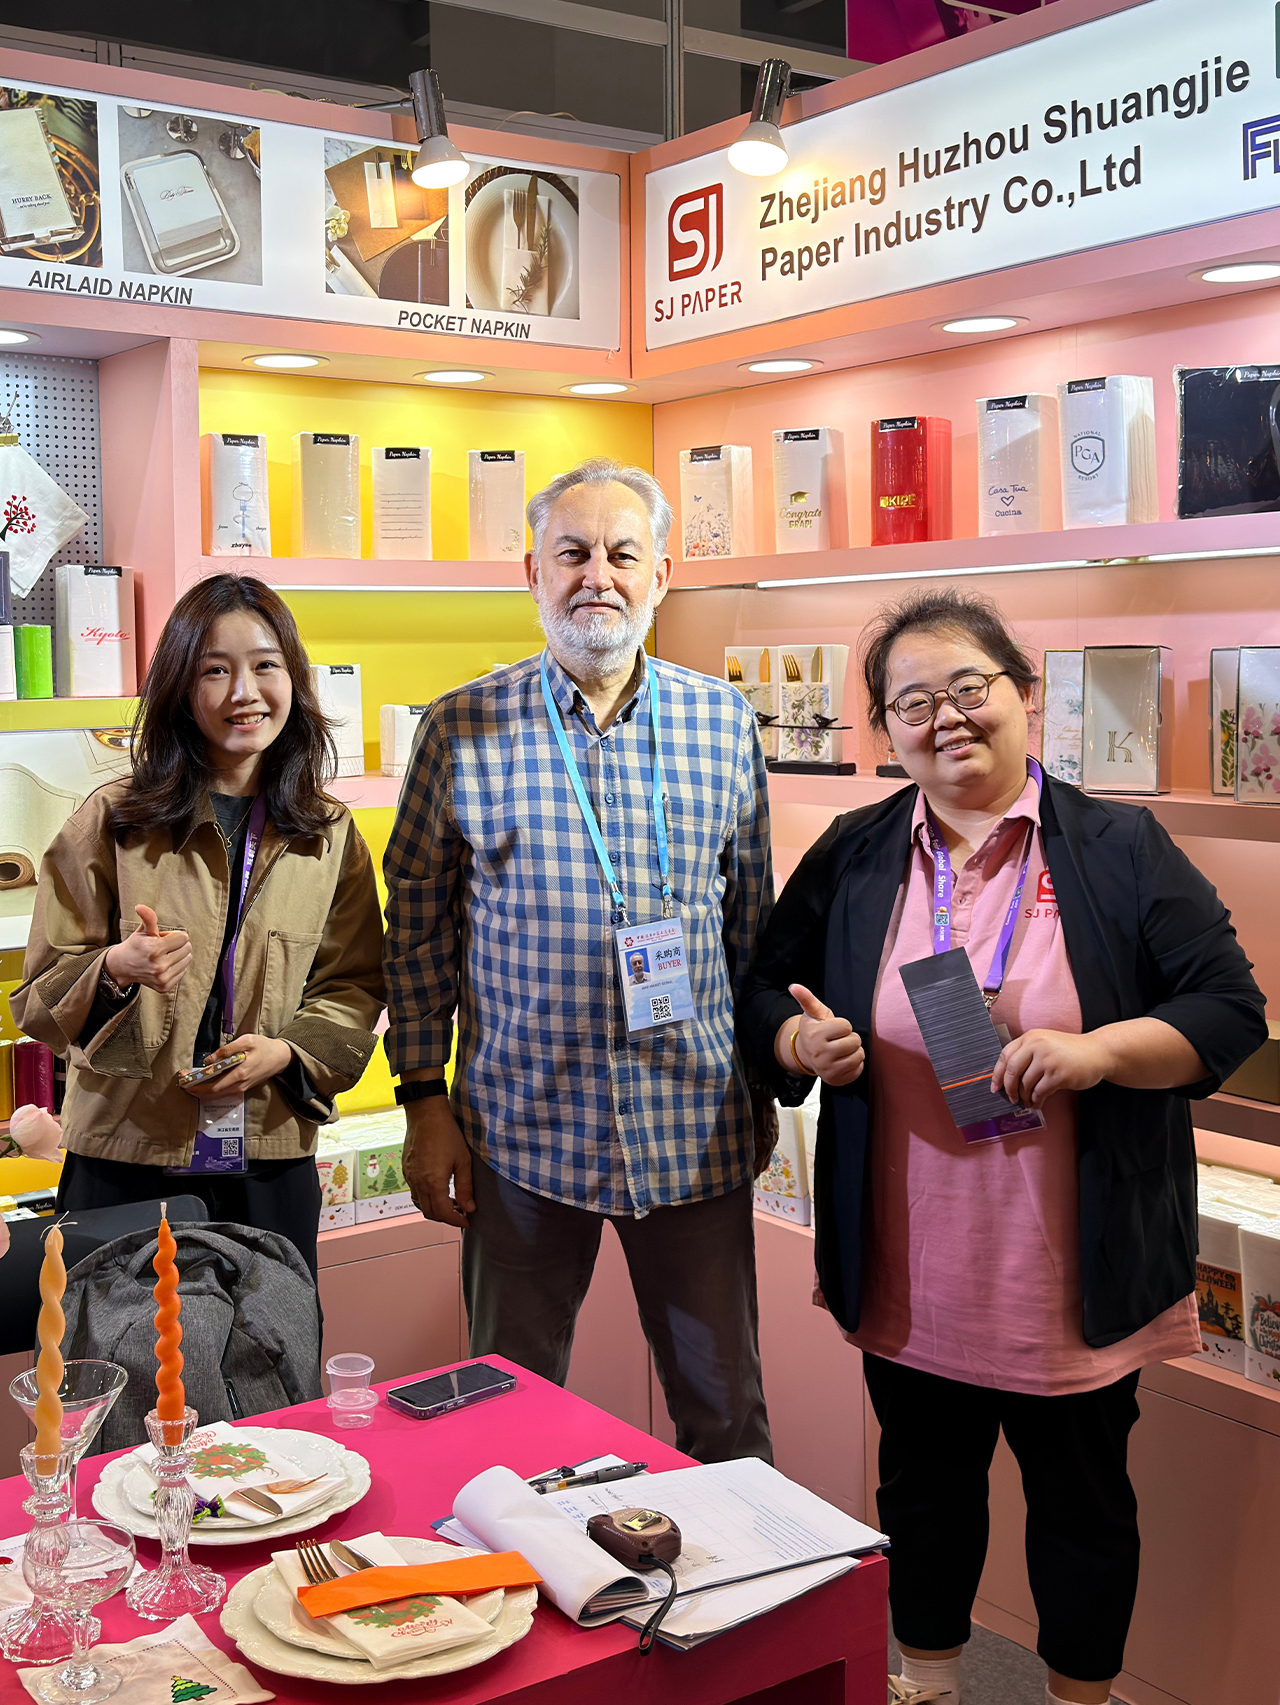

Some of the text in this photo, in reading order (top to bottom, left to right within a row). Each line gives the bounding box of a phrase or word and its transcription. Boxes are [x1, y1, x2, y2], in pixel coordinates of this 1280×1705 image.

[760, 56, 1251, 230] Zhejiang Huzhou Shuangjie
[761, 145, 1143, 282] Paper Industry Co.,Ltd
[28, 269, 194, 305] AIRLAID NAPKIN
[654, 280, 743, 322] SJ PAPER
[397, 310, 531, 340] POCKET NAPKIN
[1070, 382, 1102, 392] Paper Napkin
[1005, 400, 1023, 408] Napkin
[883, 420, 895, 429] Paper
[1073, 430, 1102, 438] NATIONAL
[240, 438, 256, 446] Napkin
[1075, 445, 1100, 469] PGA
[1078, 473, 1100, 482] RESORT
[988, 484, 1028, 496] Casa Tua
[779, 508, 822, 522] Congrats
[995, 509, 1022, 517] Cucina
[788, 520, 812, 529] GRAD!
[80, 627, 130, 646] Kyoto
[1107, 731, 1134, 762] K
[936, 850, 947, 898] Global Share
[1024, 908, 1040, 918] SJ
[655, 946, 682, 961] 采购商
[658, 959, 682, 972] BUYER
[1196, 1264, 1225, 1278] HAPPY
